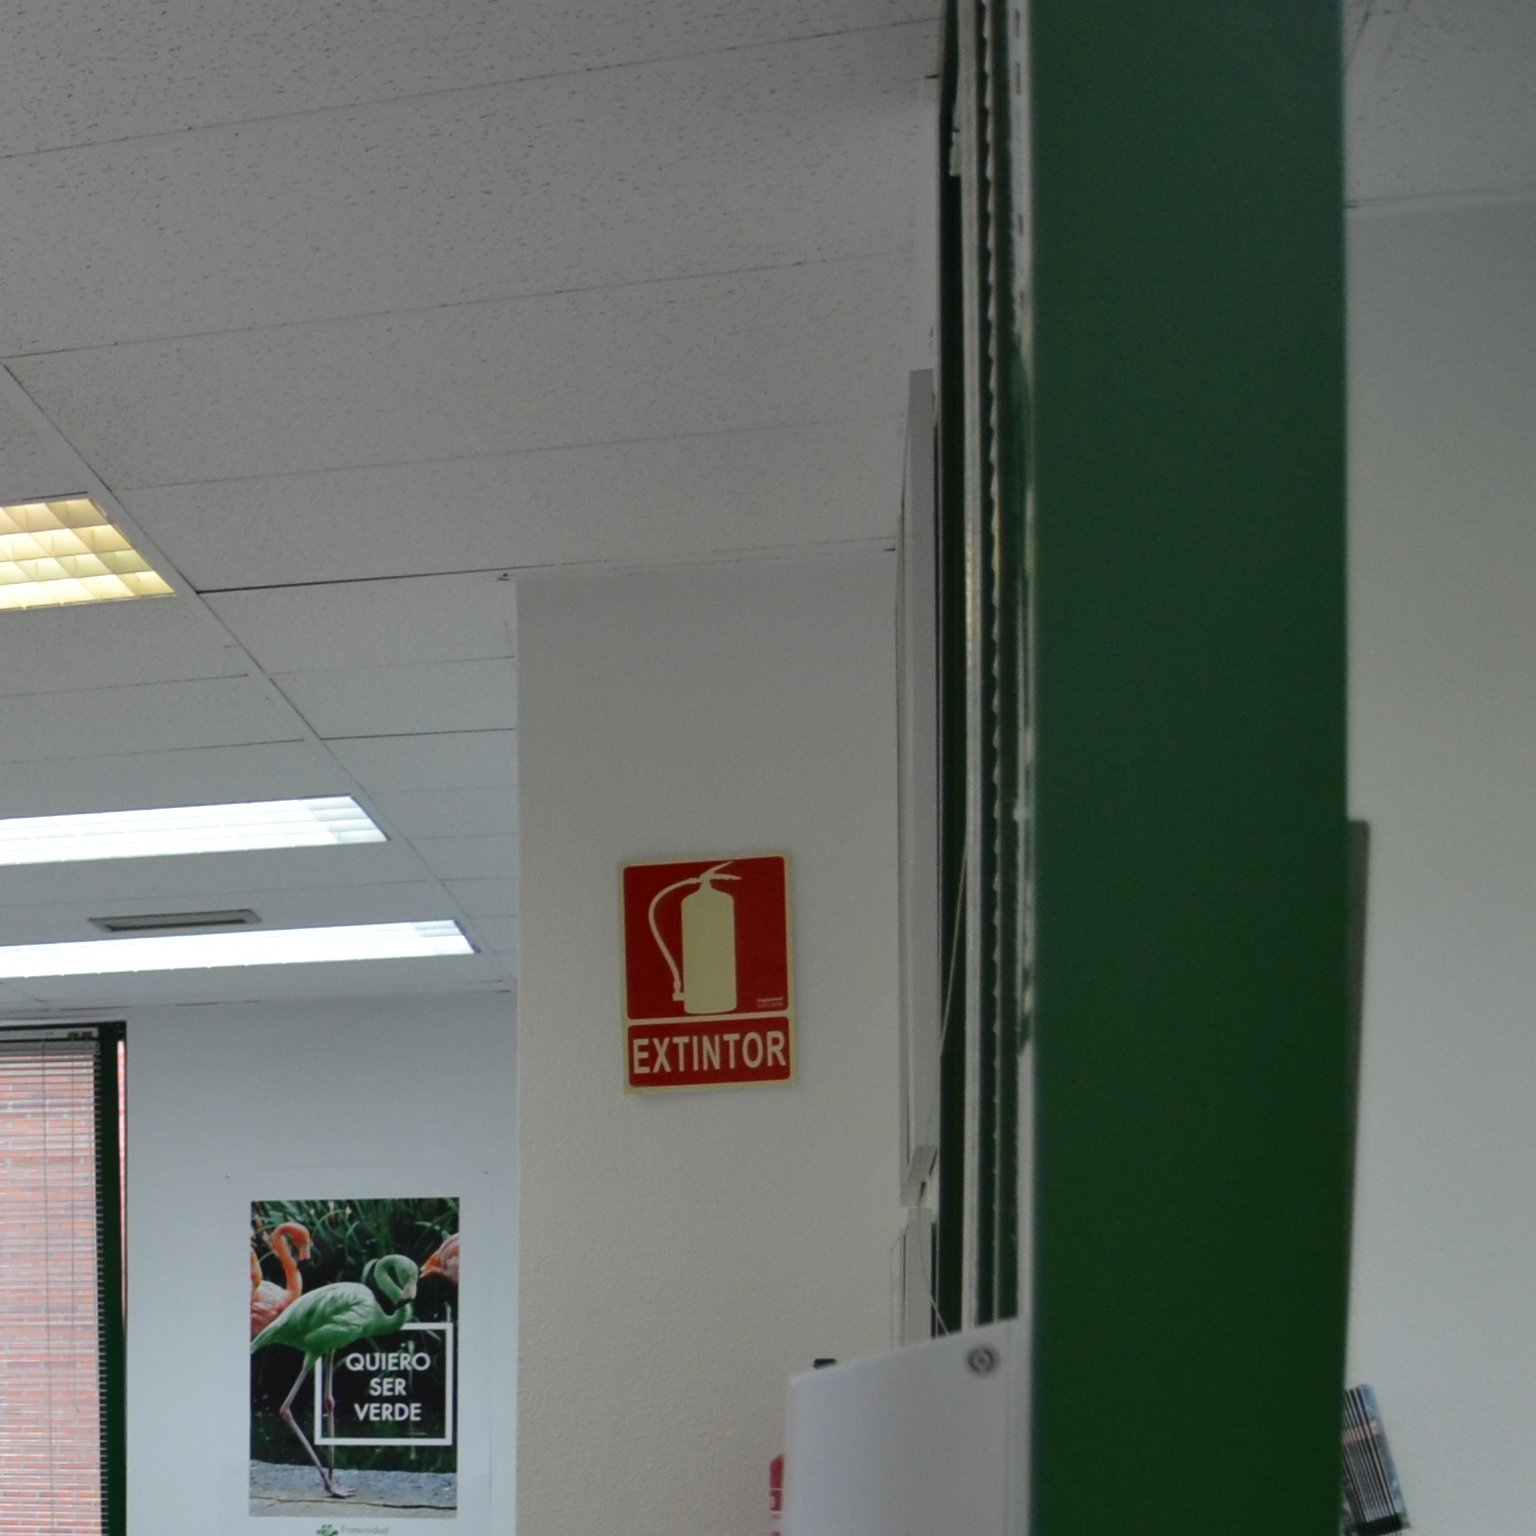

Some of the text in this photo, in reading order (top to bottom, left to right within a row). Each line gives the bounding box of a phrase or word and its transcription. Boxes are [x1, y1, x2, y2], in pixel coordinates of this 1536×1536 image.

[632, 1030, 787, 1074] EXTINTOR
[345, 1352, 431, 1372] QUIERO
[369, 1377, 407, 1396] SER
[354, 1403, 422, 1421] VERDE
